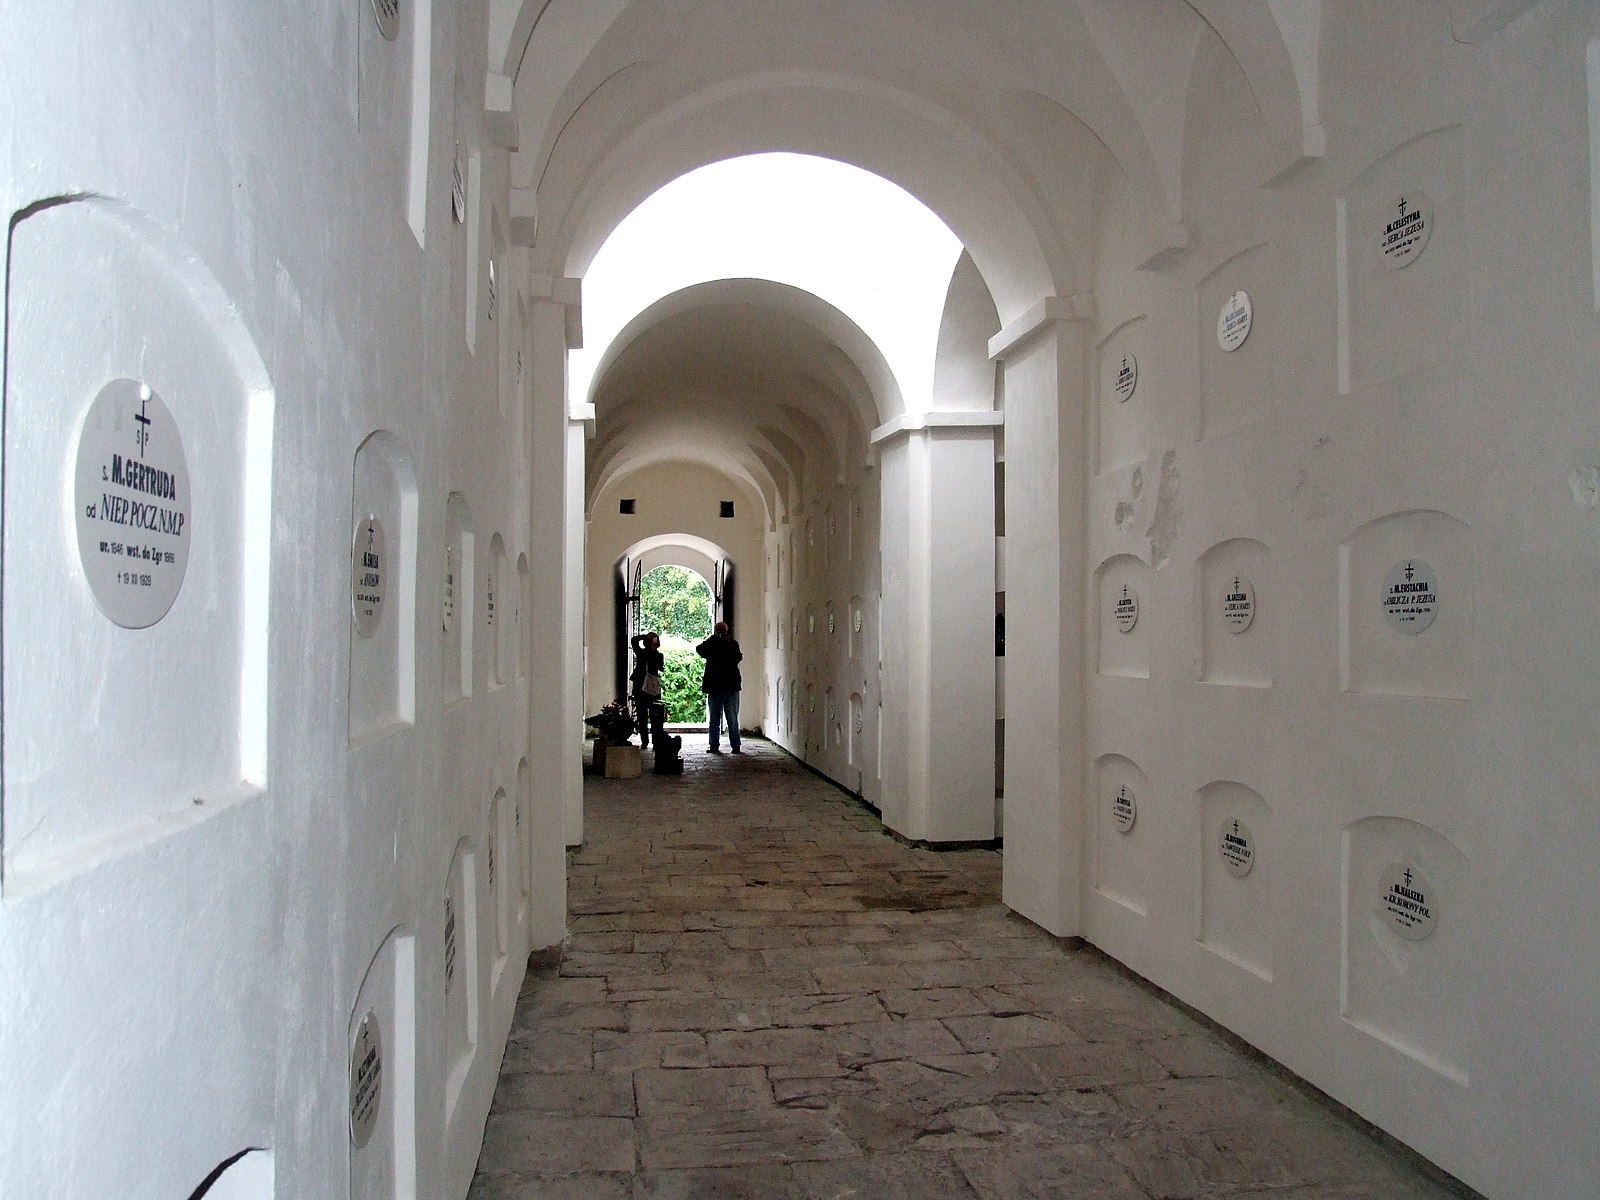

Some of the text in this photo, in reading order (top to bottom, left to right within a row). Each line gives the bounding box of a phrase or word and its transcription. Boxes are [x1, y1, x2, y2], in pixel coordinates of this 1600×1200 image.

[111, 453, 176, 501] M.GERTRUDA
[86, 503, 96, 519] od
[100, 493, 129, 525] NIEP.
[99, 541, 110, 553] ur.
[126, 545, 141, 558] wst.
[142, 545, 150, 560] do
[152, 547, 162, 566] Zgr
